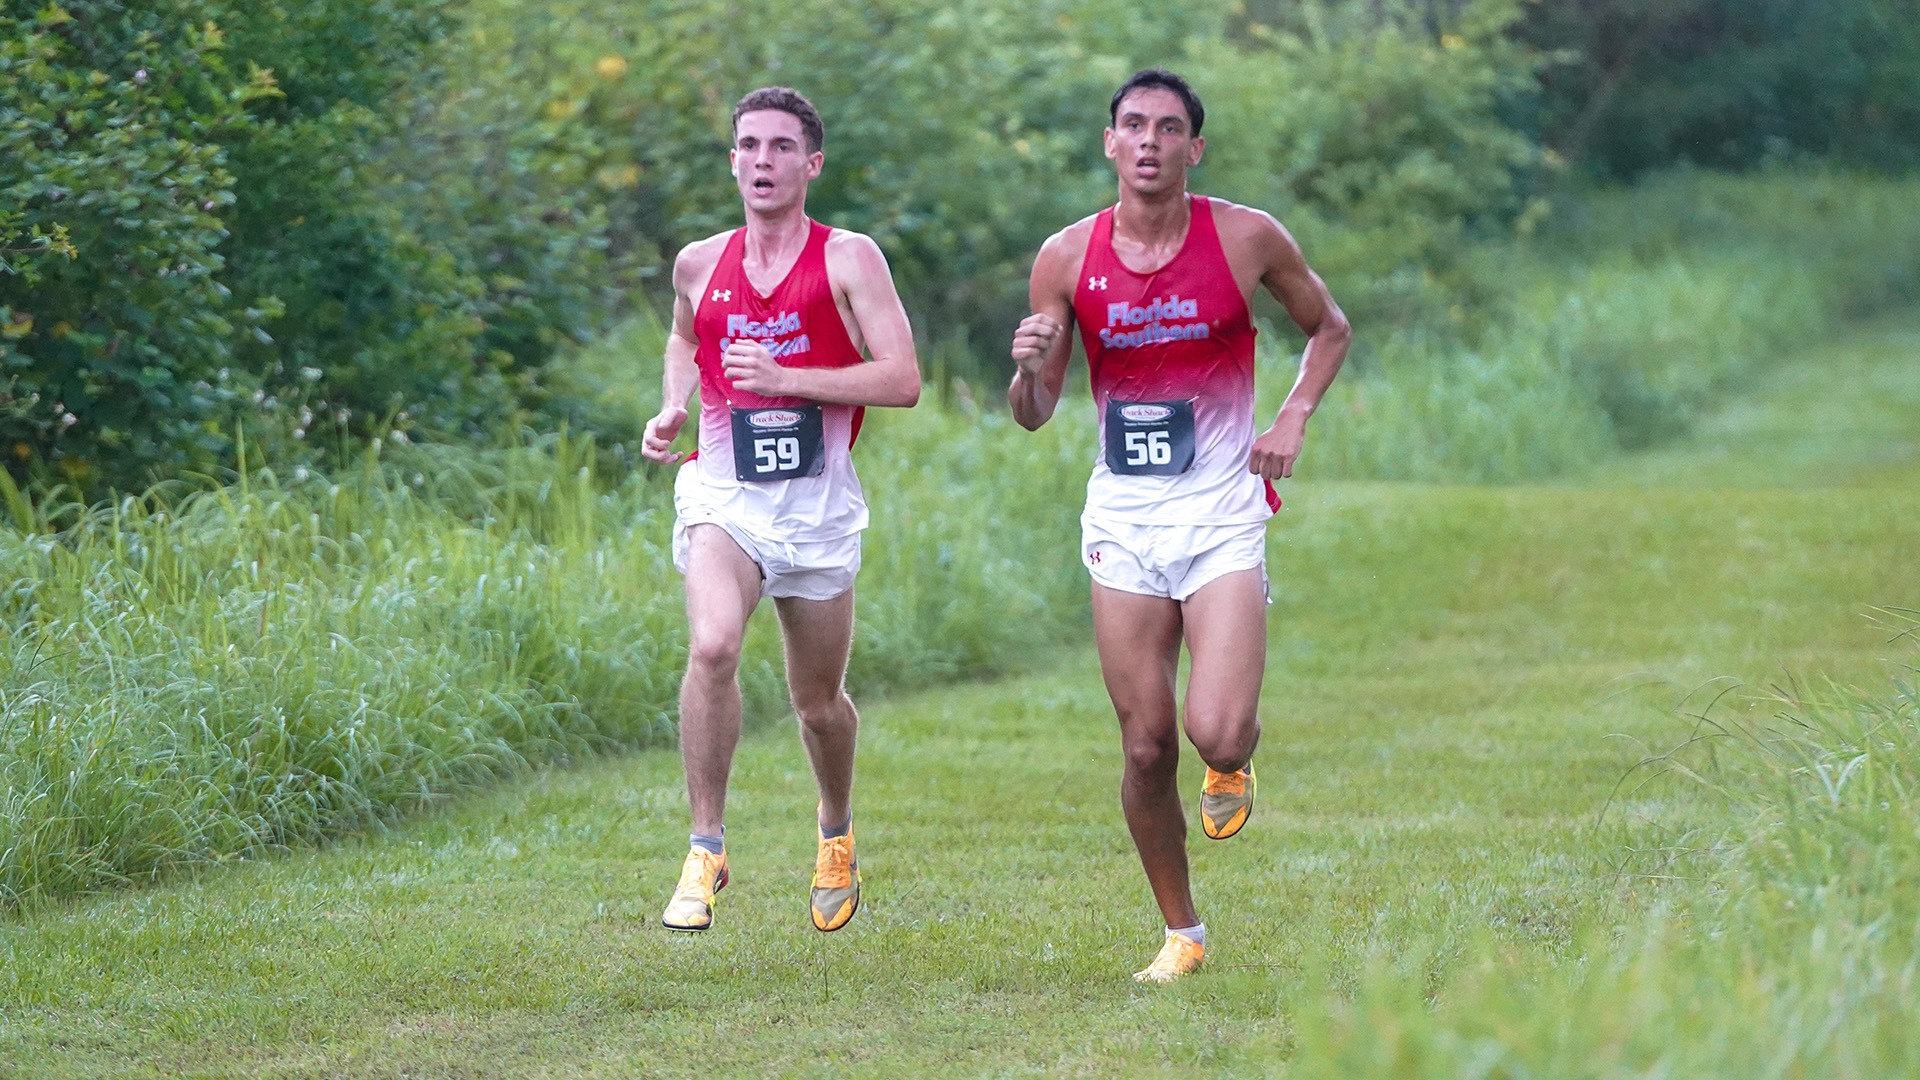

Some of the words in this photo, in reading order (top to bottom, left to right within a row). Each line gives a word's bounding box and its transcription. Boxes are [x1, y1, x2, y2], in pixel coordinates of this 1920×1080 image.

[727, 311, 801, 337] Florida
[1107, 295, 1198, 327] Florida
[720, 334, 811, 361] Sthern
[1099, 321, 1210, 349] Southern
[752, 415, 774, 423] Track
[775, 414, 801, 422] Shack
[754, 437, 800, 473] 59
[1125, 430, 1171, 466] 56
